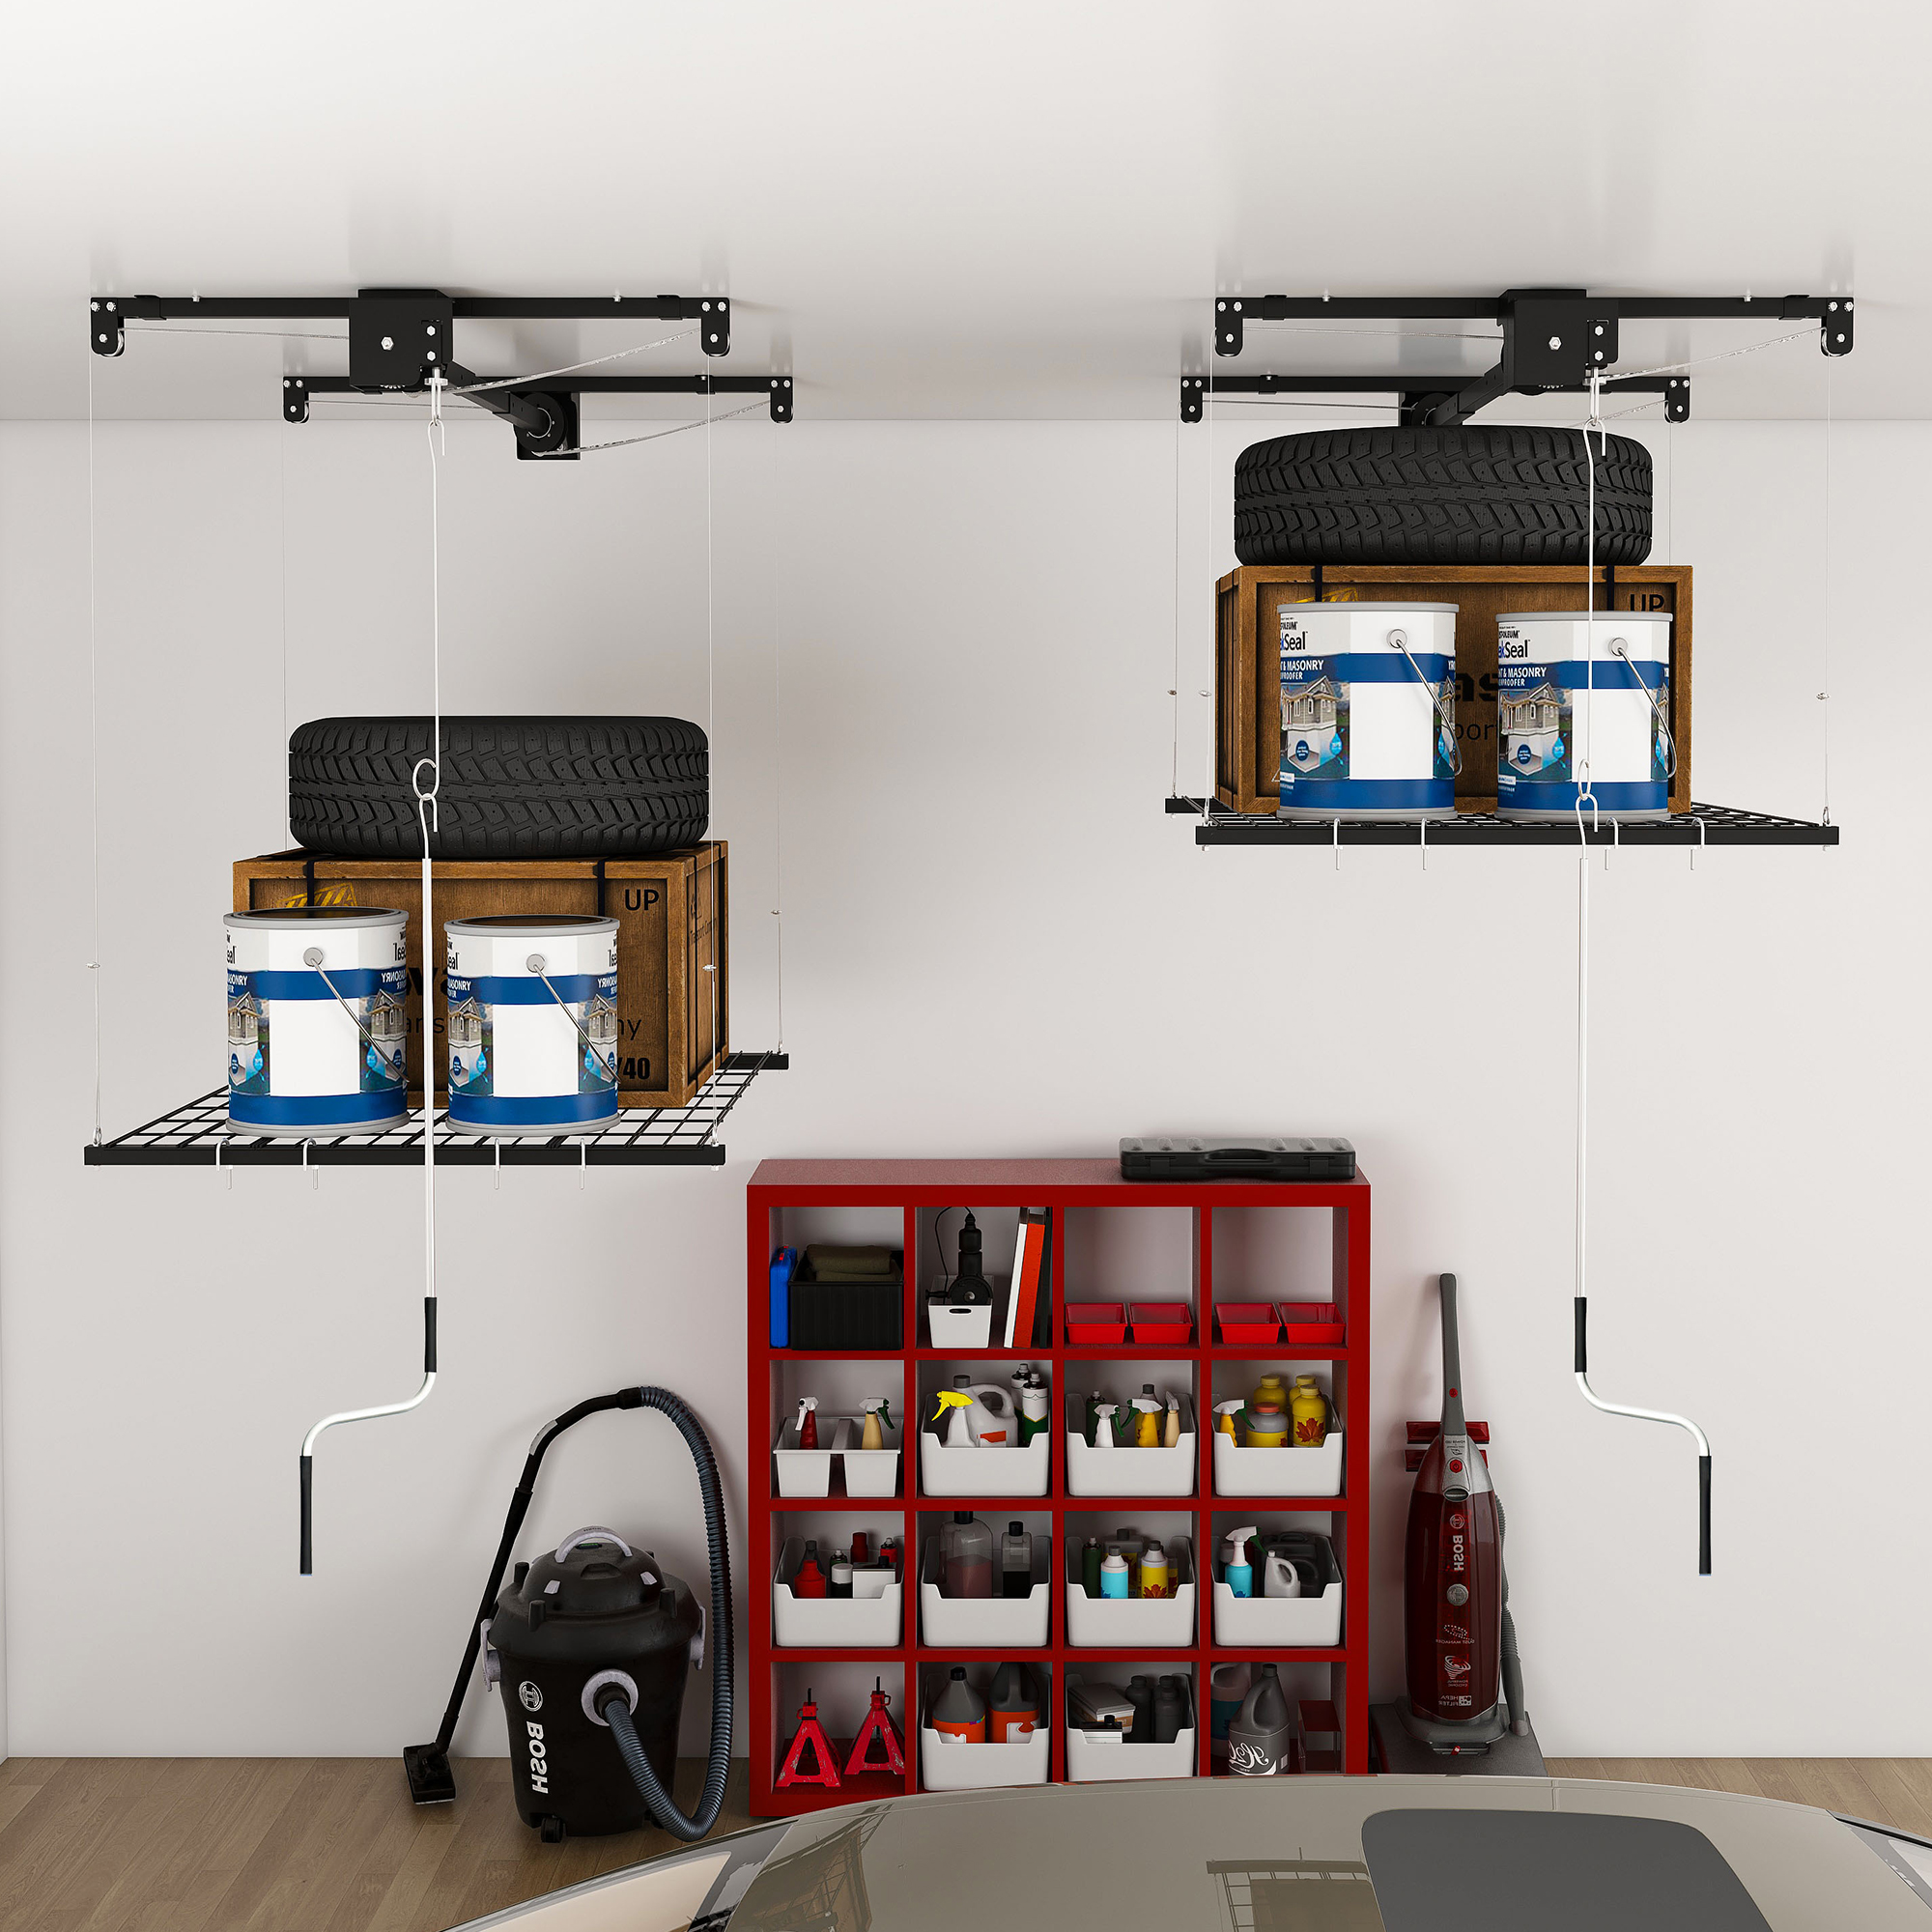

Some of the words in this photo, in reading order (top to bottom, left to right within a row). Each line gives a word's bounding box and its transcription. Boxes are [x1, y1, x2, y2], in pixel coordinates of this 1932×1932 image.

[1288, 660, 1324, 670] MASONRY
[1508, 667, 1547, 677] MASONRY
[625, 889, 659, 911] UP
